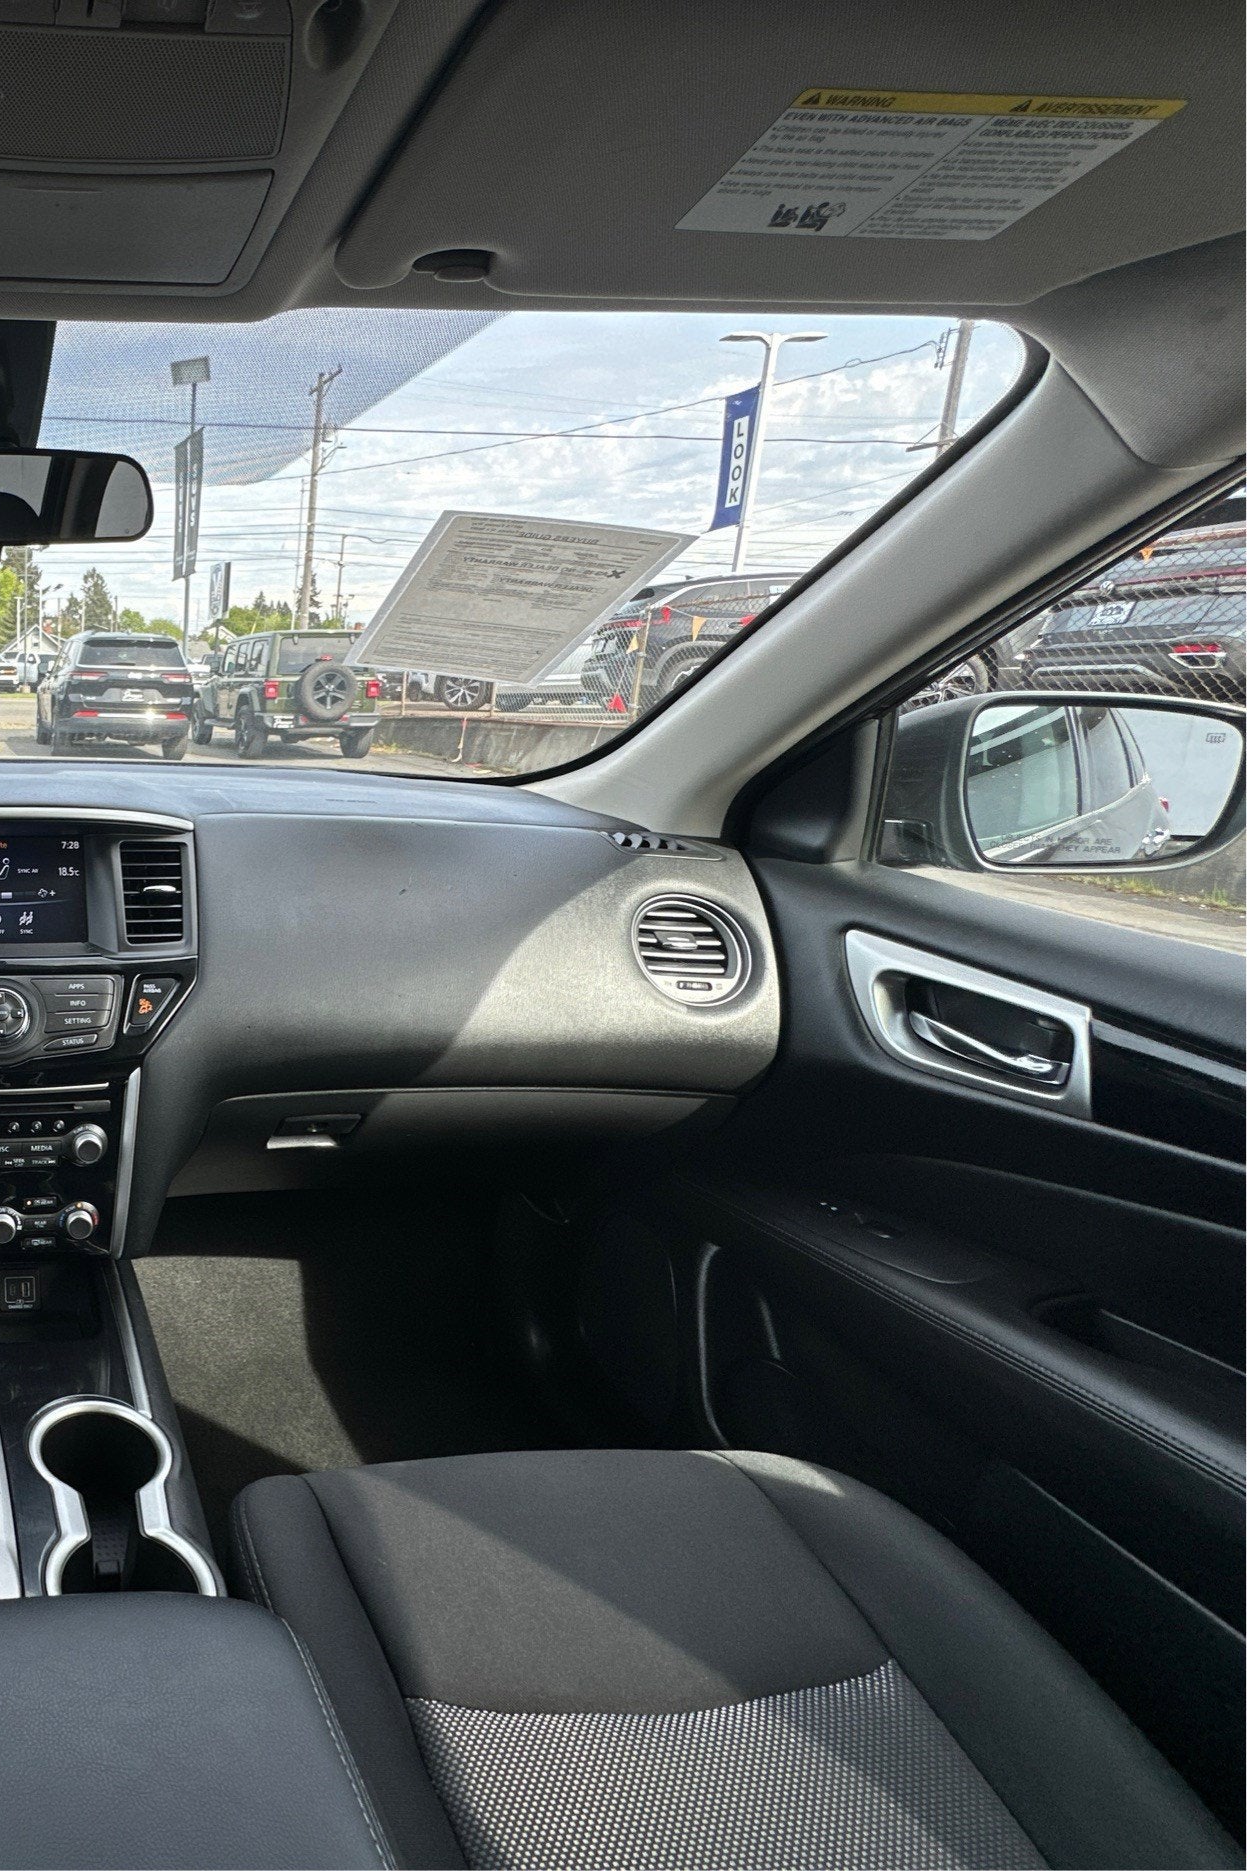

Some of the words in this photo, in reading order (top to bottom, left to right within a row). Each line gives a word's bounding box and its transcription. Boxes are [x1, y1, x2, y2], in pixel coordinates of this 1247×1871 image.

[825, 93, 897, 108] WARNING
[1031, 101, 1160, 116] AVERTISSEMENT
[783, 111, 819, 121] EVEN
[818, 112, 850, 122] WITH
[848, 113, 914, 125] ADVANCED
[913, 116, 938, 126] AIR
[936, 117, 974, 128] BAGS
[728, 421, 745, 504] LOOK
[61, 841, 81, 850] 7:28
[1094, 837, 1113, 847] ARE
[1082, 845, 1122, 855] APPEAR
[68, 982, 86, 992] APPS
[69, 999, 86, 1008] INFO
[64, 1016, 92, 1026] SETTING
[62, 1037, 85, 1046] STATUS
[31, 1144, 54, 1152] MEDIA
